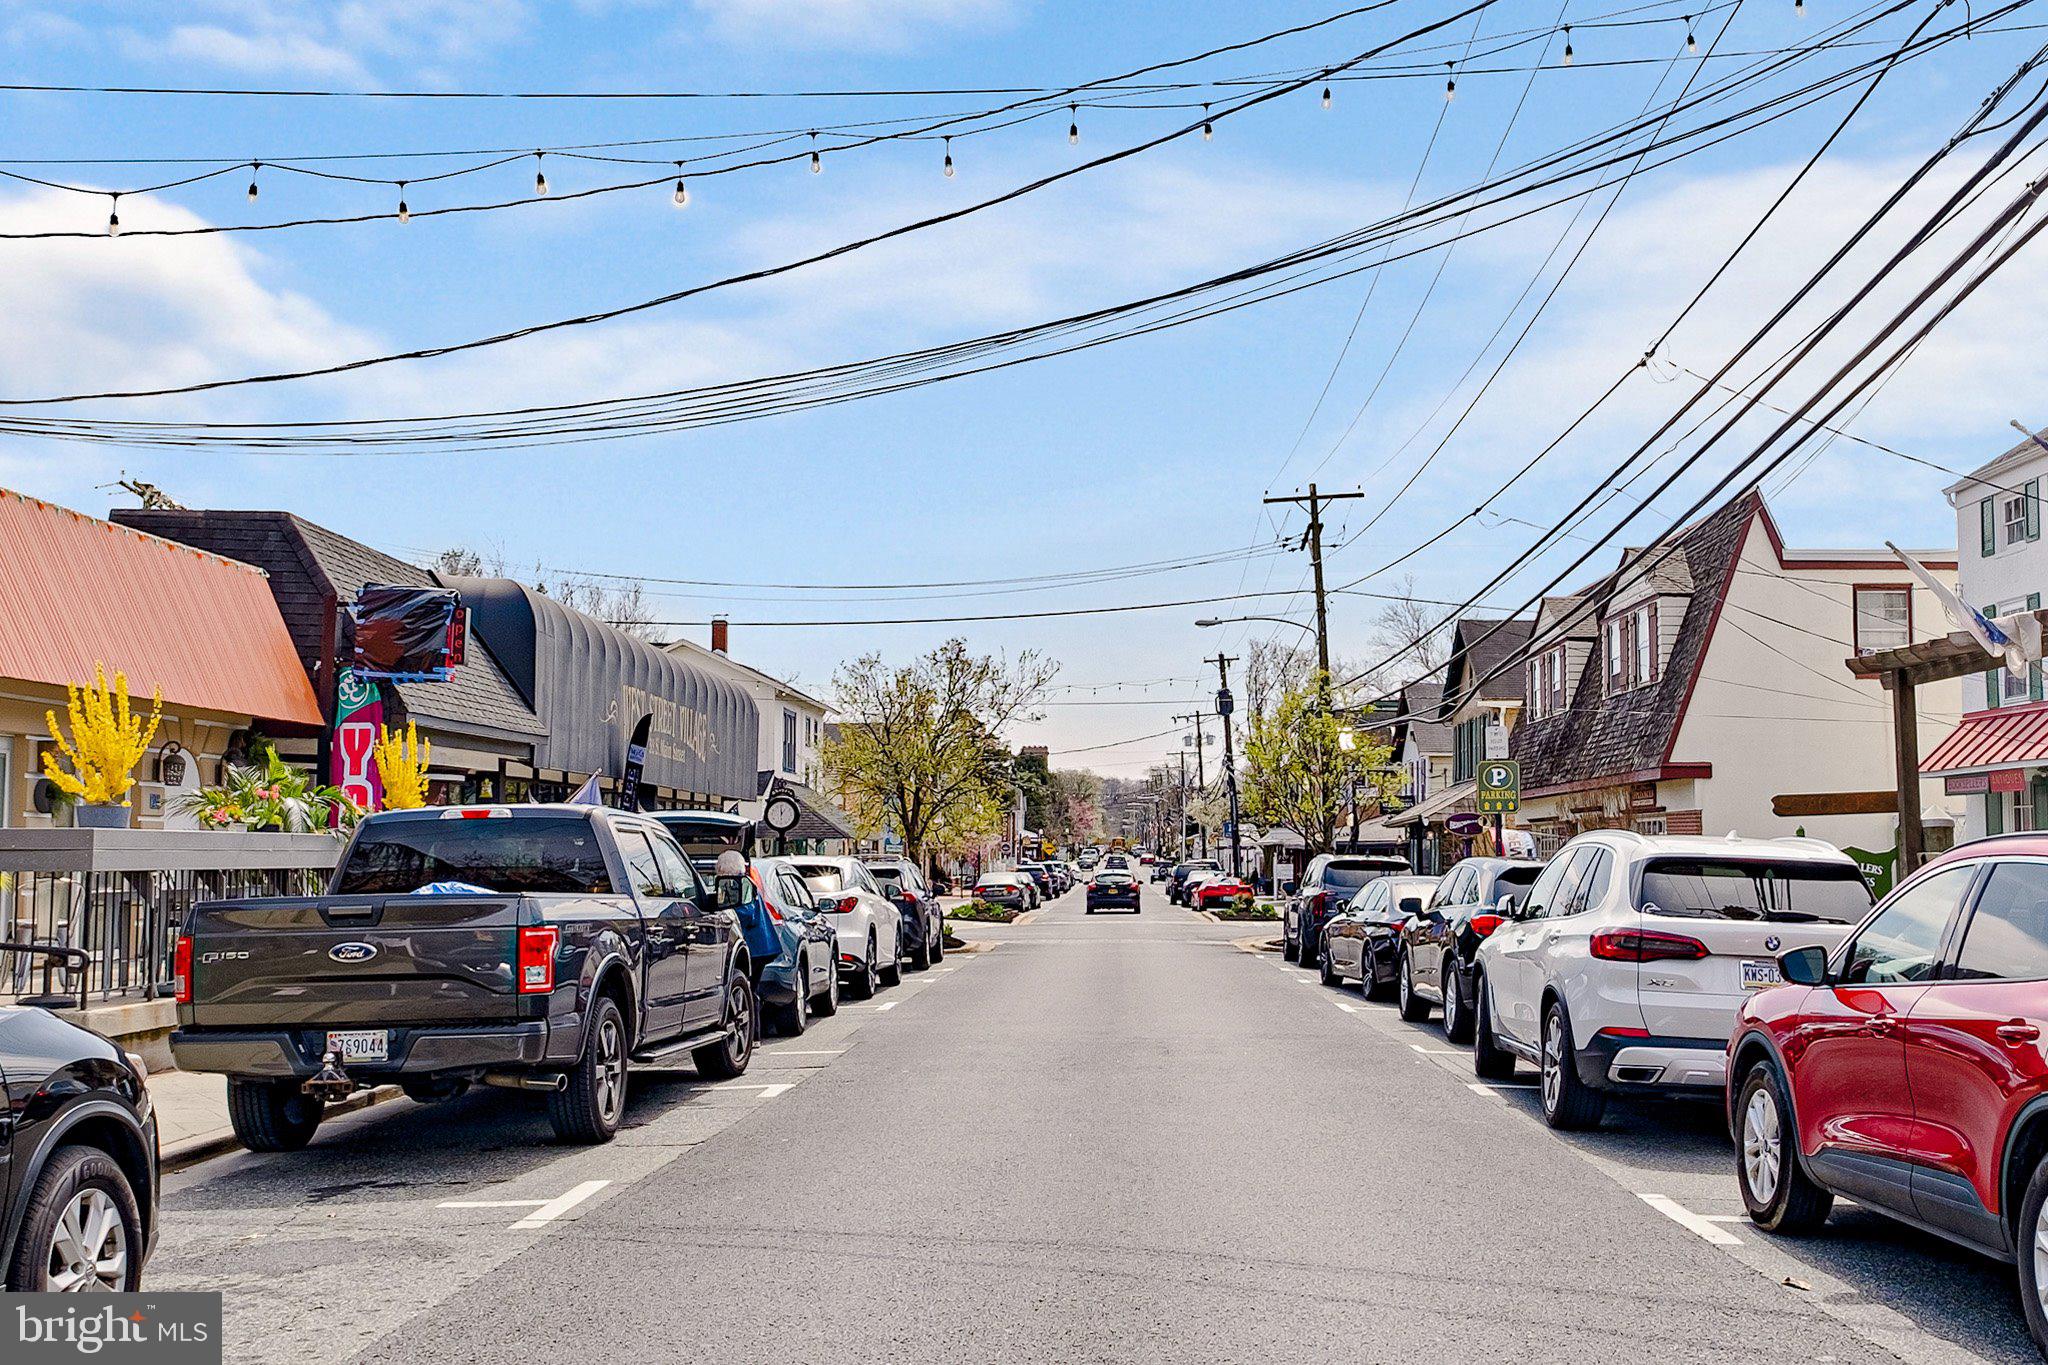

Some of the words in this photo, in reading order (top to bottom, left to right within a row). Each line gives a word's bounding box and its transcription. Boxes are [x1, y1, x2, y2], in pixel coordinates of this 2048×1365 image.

[454, 608, 464, 662] open
[1491, 768, 1507, 786] P
[1481, 790, 1516, 799] PARKING
